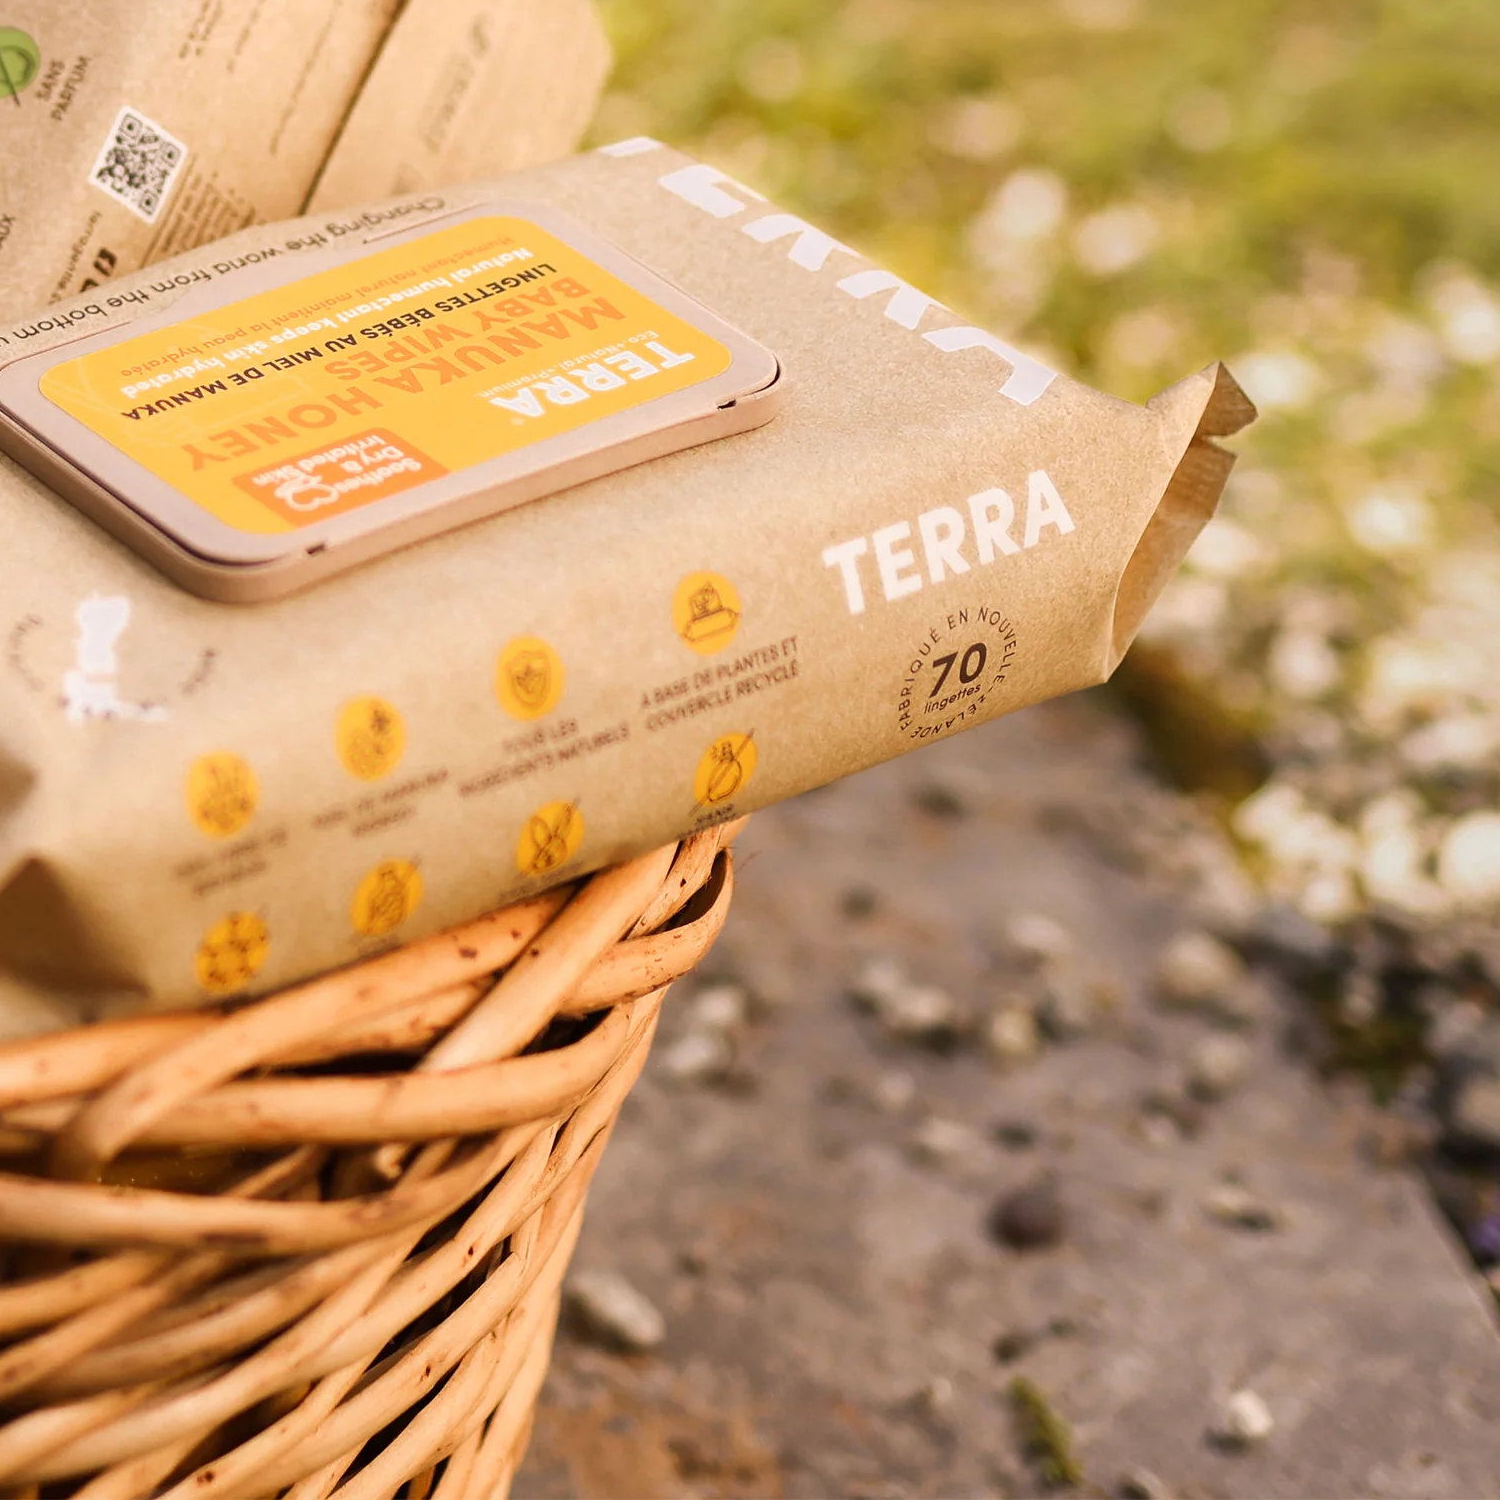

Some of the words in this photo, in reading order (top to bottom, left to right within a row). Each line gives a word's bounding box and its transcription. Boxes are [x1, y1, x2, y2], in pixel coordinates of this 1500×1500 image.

[35, 59, 66, 102] SANS
[51, 54, 91, 122] PARFUM
[328, 197, 445, 239] Changing
[285, 227, 331, 251] the
[152, 266, 212, 294] from
[356, 268, 416, 298] naturel
[450, 246, 534, 283] Natural
[107, 285, 149, 310] the
[338, 271, 452, 322] humectant
[435, 262, 558, 315] LINGETTES
[471, 276, 593, 332] BABY
[13, 304, 106, 344] bottom
[271, 291, 354, 324] maintient
[360, 307, 436, 339] BÉBÉS
[202, 328, 248, 349] peau
[251, 322, 270, 334] la
[269, 316, 338, 346] keeps
[325, 333, 358, 353] AU
[388, 297, 627, 394] MANUKA
[120, 340, 204, 378] hydratée
[223, 337, 268, 362] skin
[263, 347, 323, 373] MIEL
[323, 322, 473, 381] WIPES
[119, 354, 225, 399] hydrated
[227, 368, 265, 387] DE
[121, 379, 230, 420] MANUKA
[181, 386, 384, 472] HONEY
[298, 434, 386, 467] Irritated
[362, 445, 404, 467] Dry
[252, 463, 301, 486] Skin
[336, 457, 422, 494] Soothes
[821, 469, 1076, 615] TERRA
[694, 670, 712, 690] DE
[716, 643, 779, 684] PLANTES
[781, 635, 798, 658] ET
[736, 658, 799, 699] RECYCLÉ
[898, 627, 942, 731] FABRIQUÉ
[947, 608, 968, 630] EN
[928, 642, 987, 698] 70
[924, 683, 981, 714] lingettes
